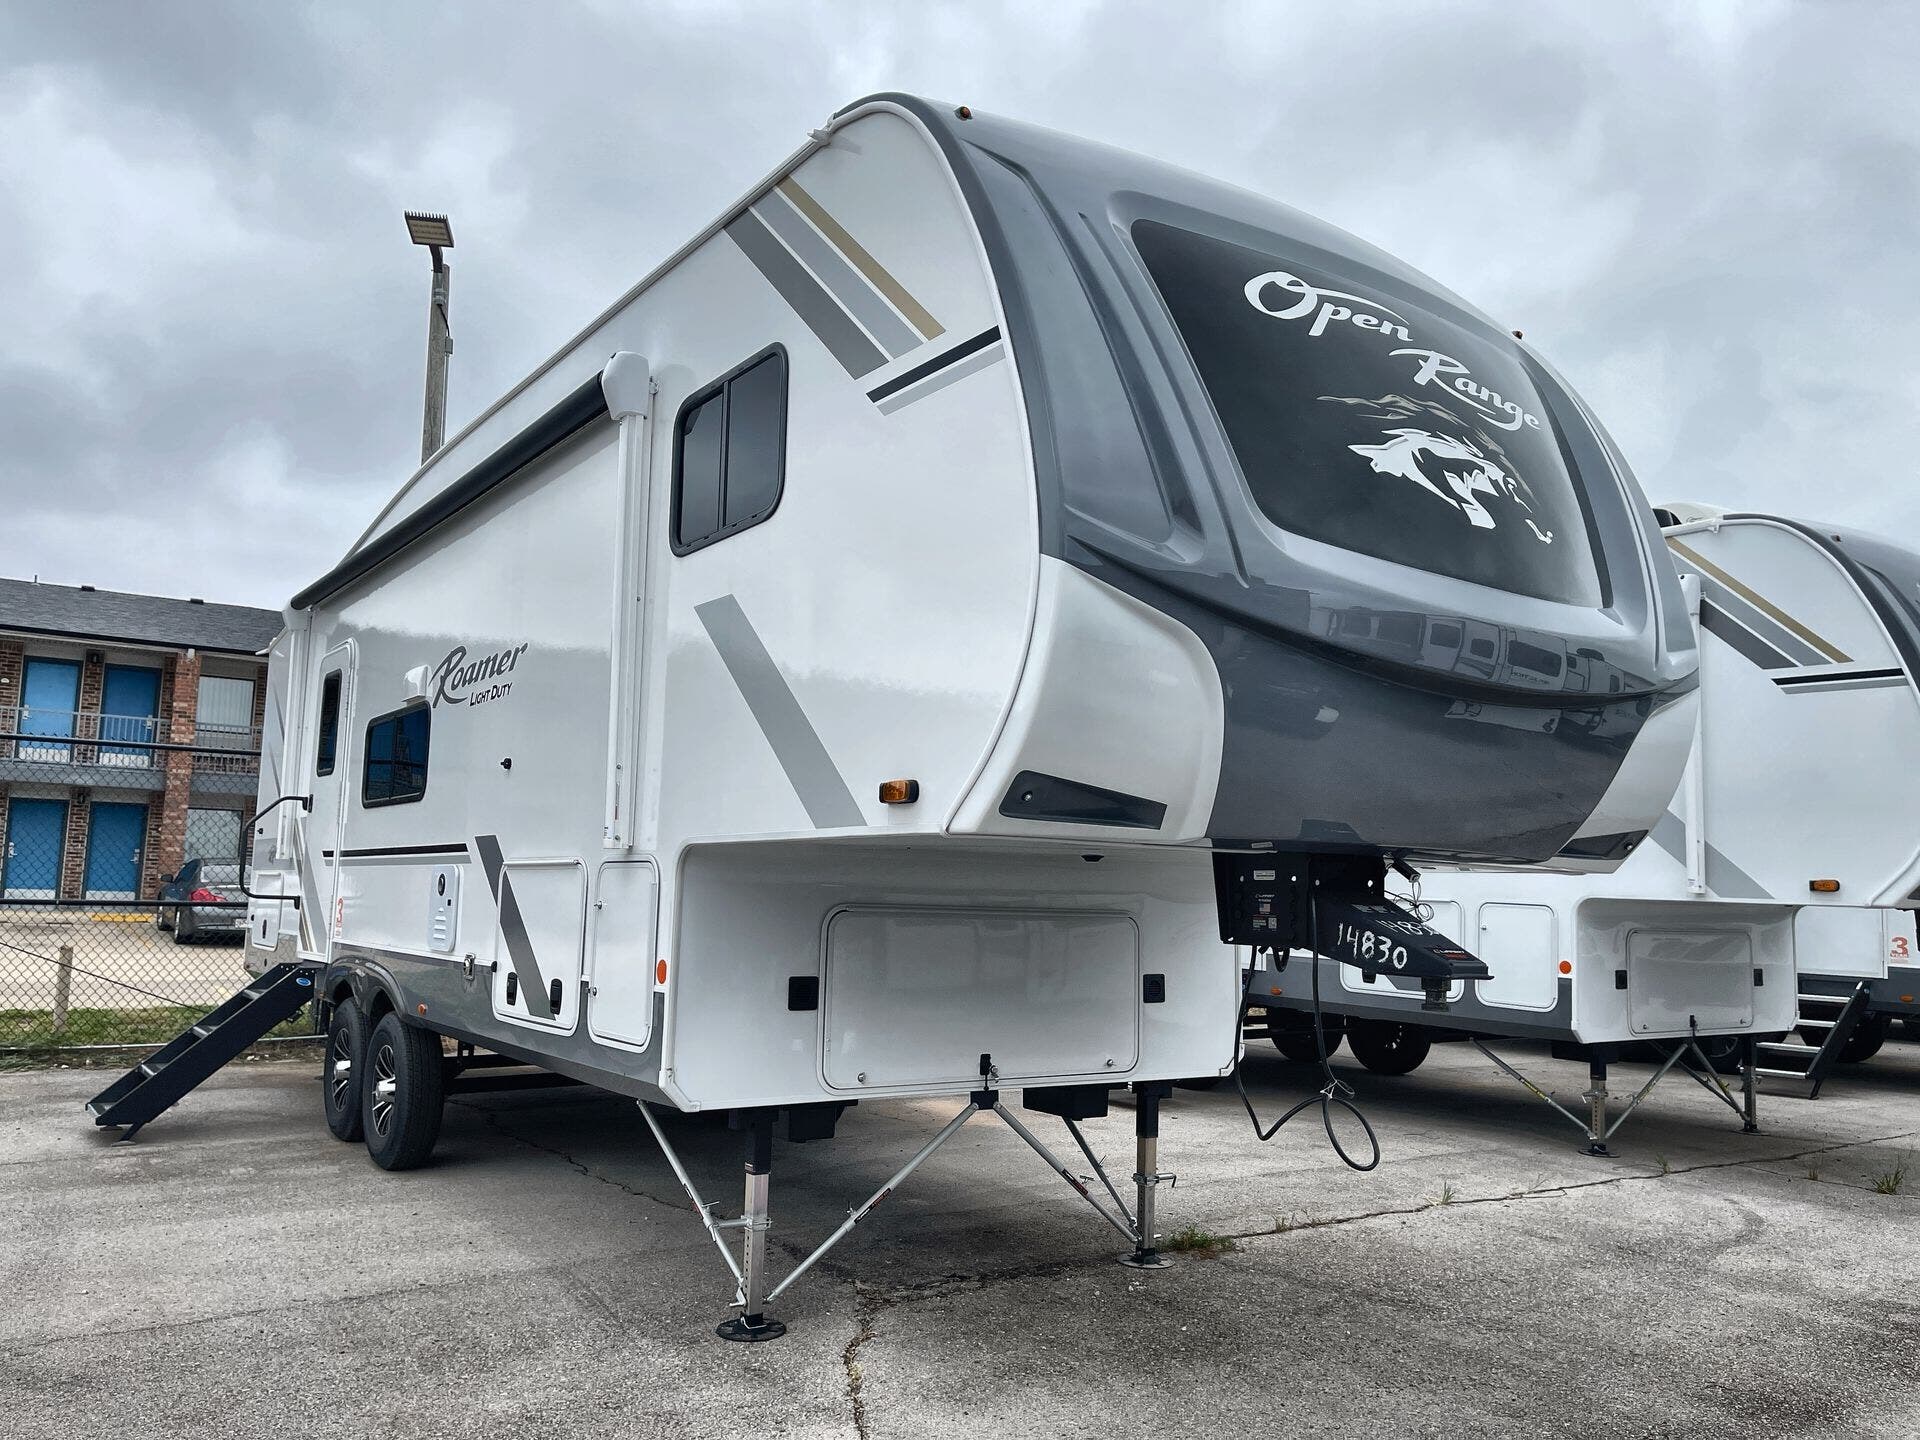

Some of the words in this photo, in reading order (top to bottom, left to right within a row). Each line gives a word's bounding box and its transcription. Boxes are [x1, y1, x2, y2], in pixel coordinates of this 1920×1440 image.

[1244, 271, 1413, 341] Open
[1389, 348, 1541, 431] Range
[428, 643, 528, 708] Roamer
[469, 688, 491, 707] LIGHT
[490, 682, 513, 701] DUTY
[1337, 923, 1408, 969] 14830
[1891, 936, 1909, 955] 3
